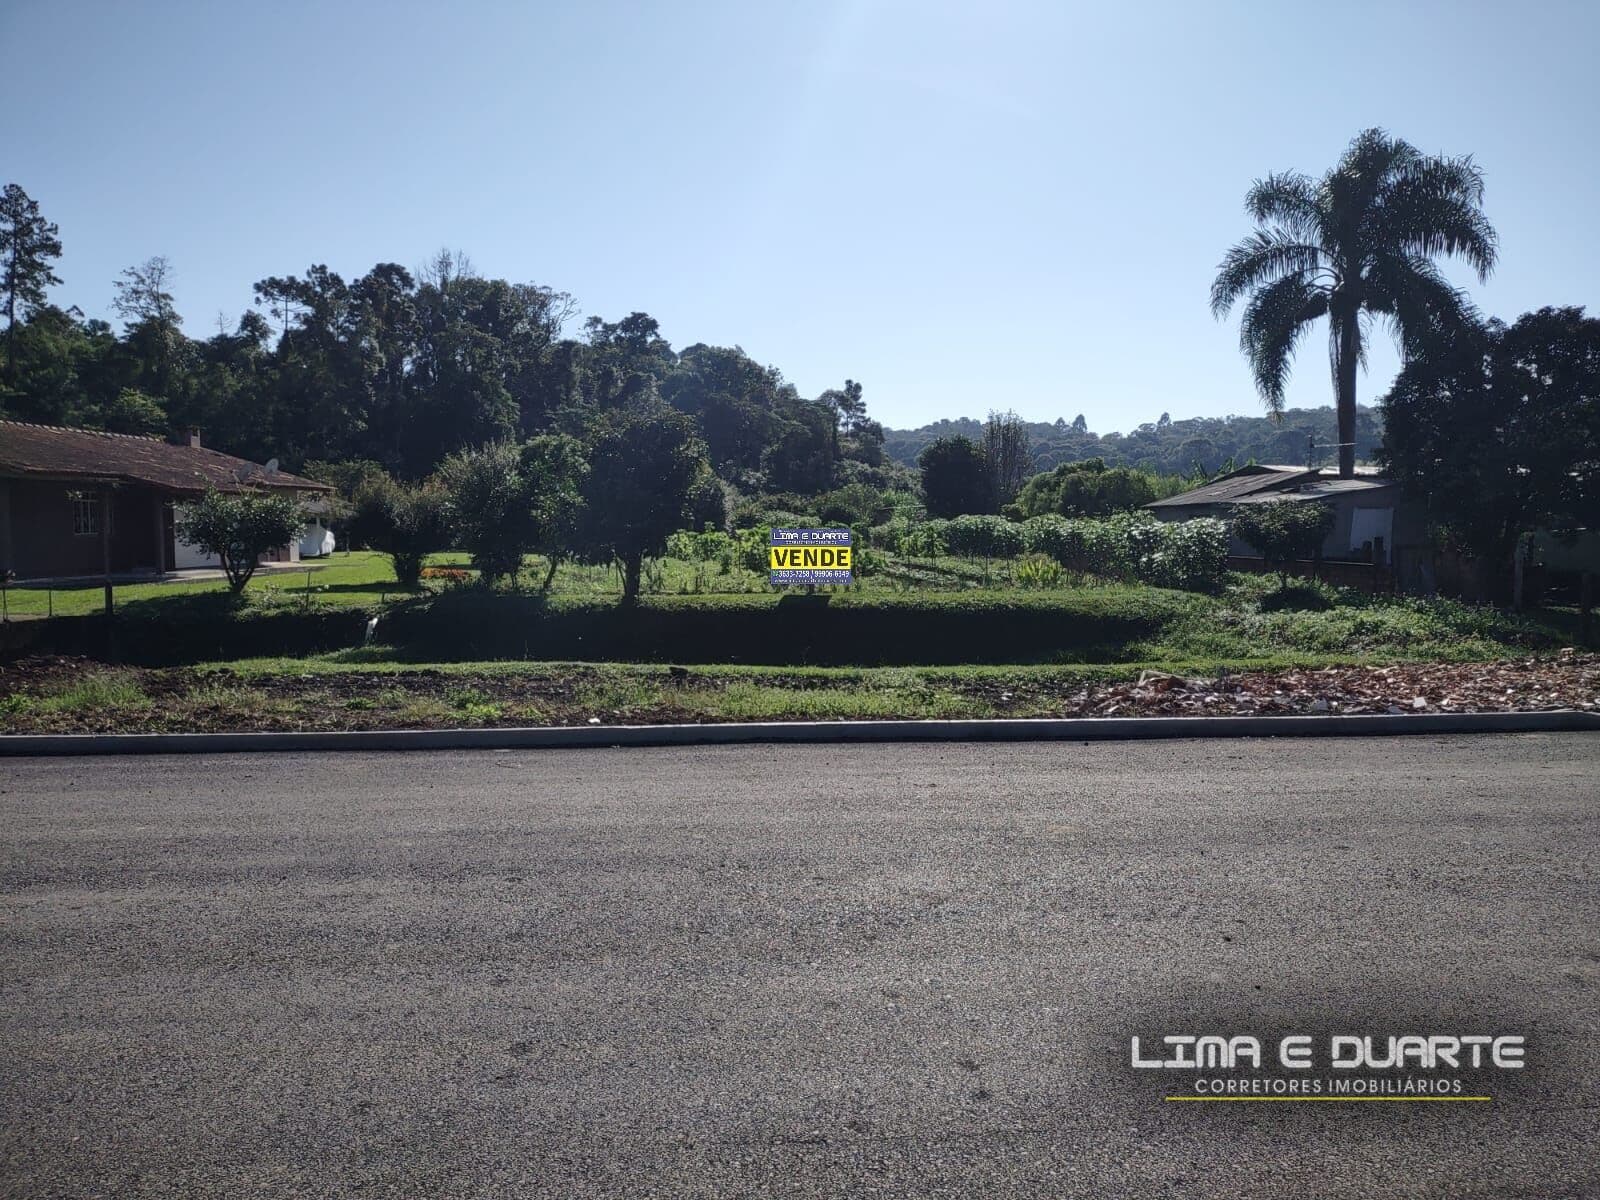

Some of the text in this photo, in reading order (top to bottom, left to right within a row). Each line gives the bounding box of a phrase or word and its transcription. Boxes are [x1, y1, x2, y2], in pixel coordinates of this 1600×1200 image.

[773, 532, 849, 540] LIMA E DUARTE
[774, 549, 849, 567] VENDE
